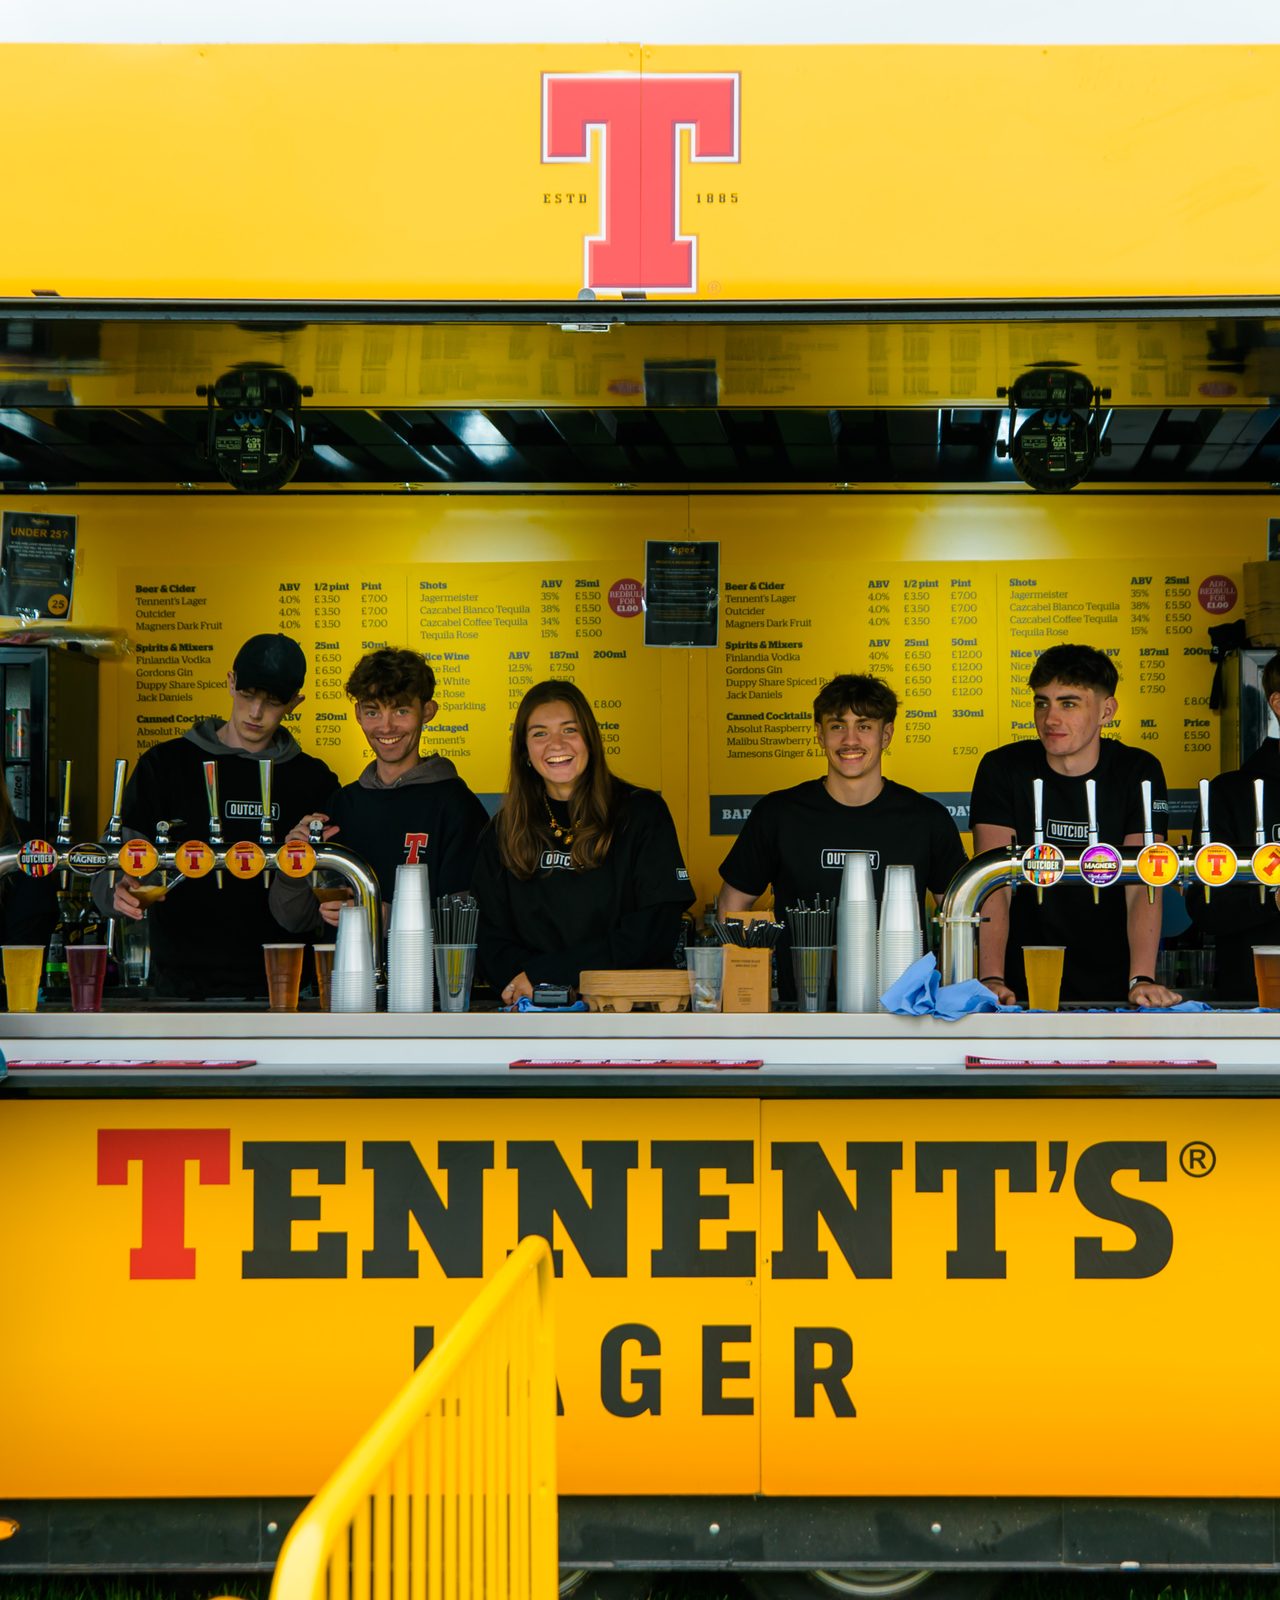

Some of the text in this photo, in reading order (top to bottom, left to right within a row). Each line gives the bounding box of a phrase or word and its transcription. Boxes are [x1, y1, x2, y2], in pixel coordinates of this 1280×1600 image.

[541, 72, 741, 293] T
[544, 193, 586, 203] ESTD
[697, 193, 738, 203] 1885
[11, 528, 68, 538] UNDER 25?
[541, 580, 563, 588] ABV
[575, 579, 600, 587] 25ml
[868, 580, 890, 588] ABV
[904, 579, 939, 589] 1/2 pint
[951, 579, 971, 587] Pint
[1009, 578, 1037, 587] Shots
[1131, 577, 1152, 585] ABV
[1165, 576, 1190, 584] 25ml
[135, 584, 196, 593] Beer & Cider
[279, 583, 300, 591] ABV
[314, 582, 349, 592] 1/2 pint
[361, 582, 382, 590] Pint
[725, 582, 785, 591] Beer & Cider
[278, 595, 300, 604] 4.0%
[420, 593, 479, 604] Jagermeister
[541, 592, 559, 601] 35%
[725, 594, 796, 604] Tennent's Lager
[52, 600, 64, 608] 25
[135, 597, 207, 607] Tennent's Lager
[279, 608, 300, 617] 4.0%
[420, 605, 530, 617] Cazcabel Blanco Tequila
[541, 604, 560, 613] 38%
[725, 607, 765, 616] Outcider
[136, 610, 176, 618] Outcider
[279, 620, 301, 629] 4.0%
[420, 617, 528, 628] Cazcabel Coffee Tequila
[541, 617, 560, 626] 34%
[726, 619, 812, 629] Magners Dark Fruit
[136, 621, 222, 632] Magners Dark Fruit
[420, 630, 479, 640] Tequila Rose
[541, 628, 558, 638] 15%
[725, 640, 803, 651] Spirits & Mixers
[869, 639, 890, 647] ABV
[905, 639, 929, 647] 25ml
[952, 638, 977, 646] 50ml
[135, 643, 213, 654] Spirits & Mixers
[1140, 648, 1169, 656] 187ml
[444, 652, 469, 660] Wine
[508, 651, 530, 660] ABV
[550, 651, 579, 659] 187ml
[593, 650, 627, 659] 200ml
[726, 653, 800, 662] Finlandia Vodka
[869, 651, 889, 660] 40%
[442, 664, 461, 673] Red
[508, 664, 532, 673] 12.5%
[726, 665, 782, 675] Gordons Gin
[869, 664, 894, 673] 37.5%
[442, 677, 470, 686] White
[509, 675, 533, 685] 10.5%
[726, 679, 757, 688] Duppy
[759, 678, 785, 687] Share
[786, 677, 817, 688] Spiced
[442, 689, 465, 698] Rose
[726, 690, 783, 699] Jack Daniels
[442, 702, 486, 712] Sparkling
[316, 713, 347, 721] 250ml
[726, 712, 812, 721] Canned Cocktails
[905, 710, 937, 718] 250ml
[952, 709, 984, 717] 330ml
[1141, 719, 1157, 727] ML
[1184, 719, 1210, 727] Price
[727, 725, 763, 733] Absolut
[764, 724, 811, 734] Raspberry
[422, 736, 465, 745] Tennent's
[1141, 732, 1159, 740] 440
[727, 737, 759, 746] Malibu
[760, 737, 811, 746] Strawberry
[727, 750, 773, 758] Jamesons
[774, 749, 802, 759] Ginger
[806, 749, 813, 757] &
[70, 855, 106, 864] MAGNERS
[546, 853, 571, 866] OUTC
[827, 853, 875, 865] OUTR
[1084, 862, 1116, 870] MAGNERS
[97, 1128, 1174, 1280] TENNENT'S
[414, 1323, 857, 1418] GER
